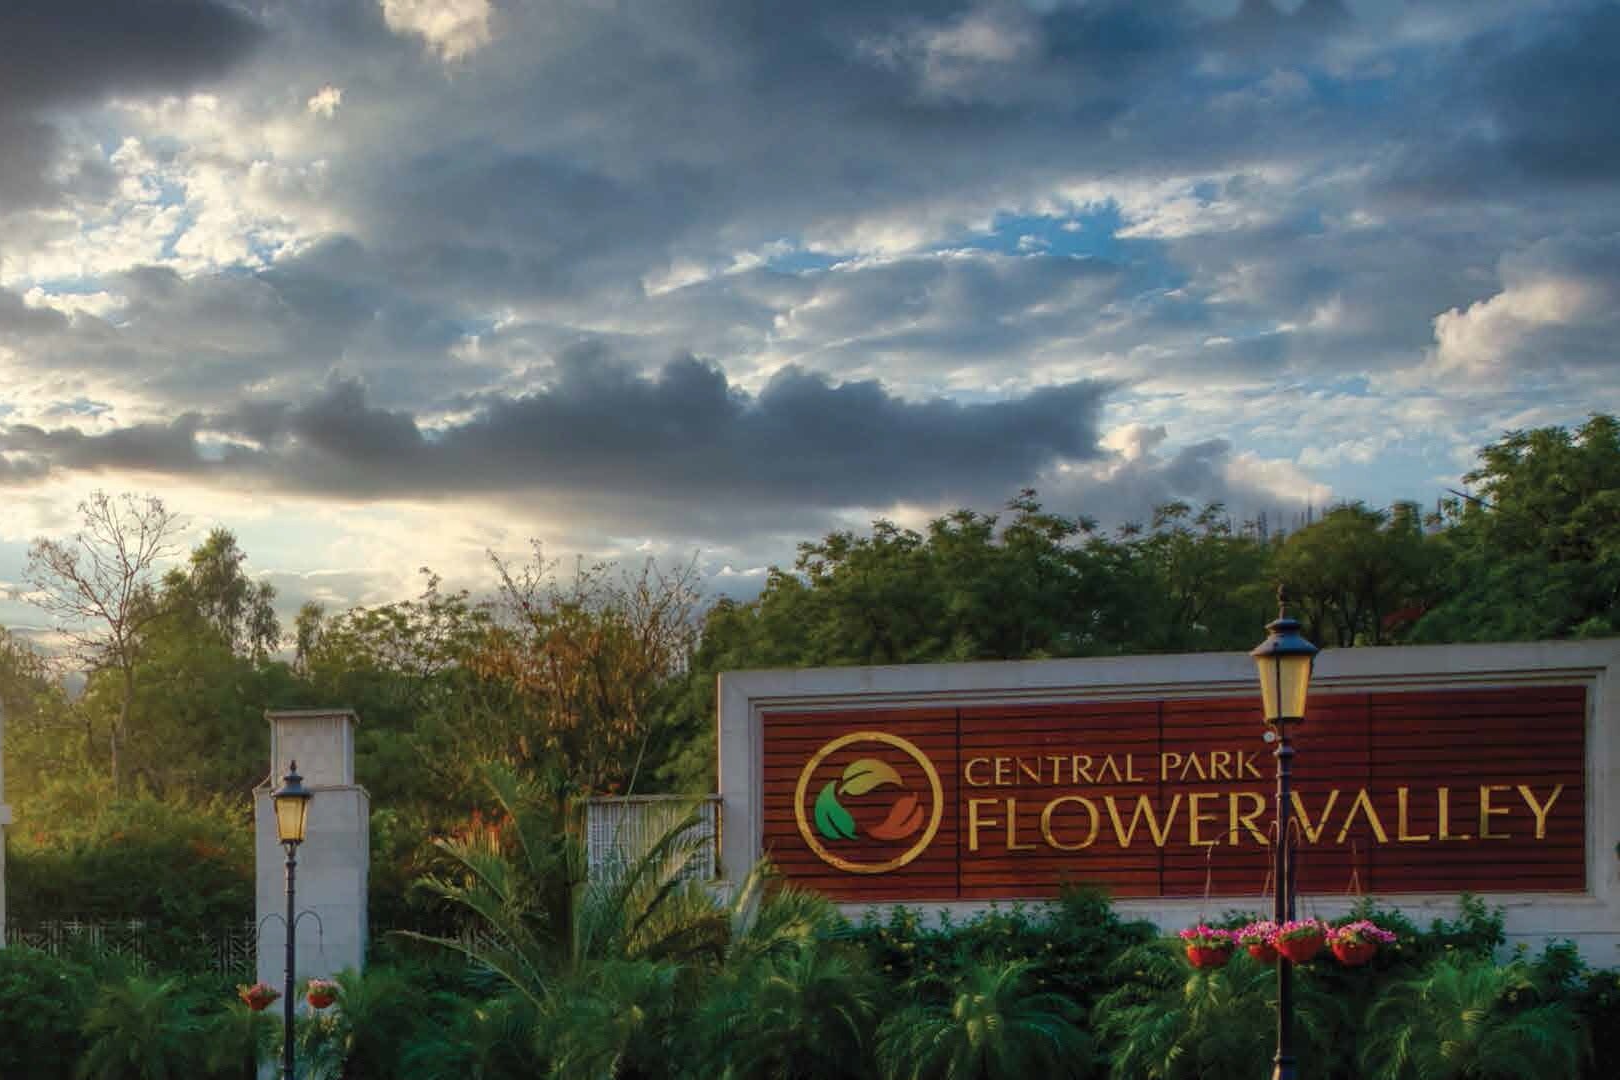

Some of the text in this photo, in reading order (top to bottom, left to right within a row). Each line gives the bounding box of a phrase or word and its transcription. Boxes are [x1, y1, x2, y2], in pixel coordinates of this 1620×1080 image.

[964, 751, 1262, 786] CENTRAL PARK
[967, 784, 1564, 851] FLOWER VALLEY
